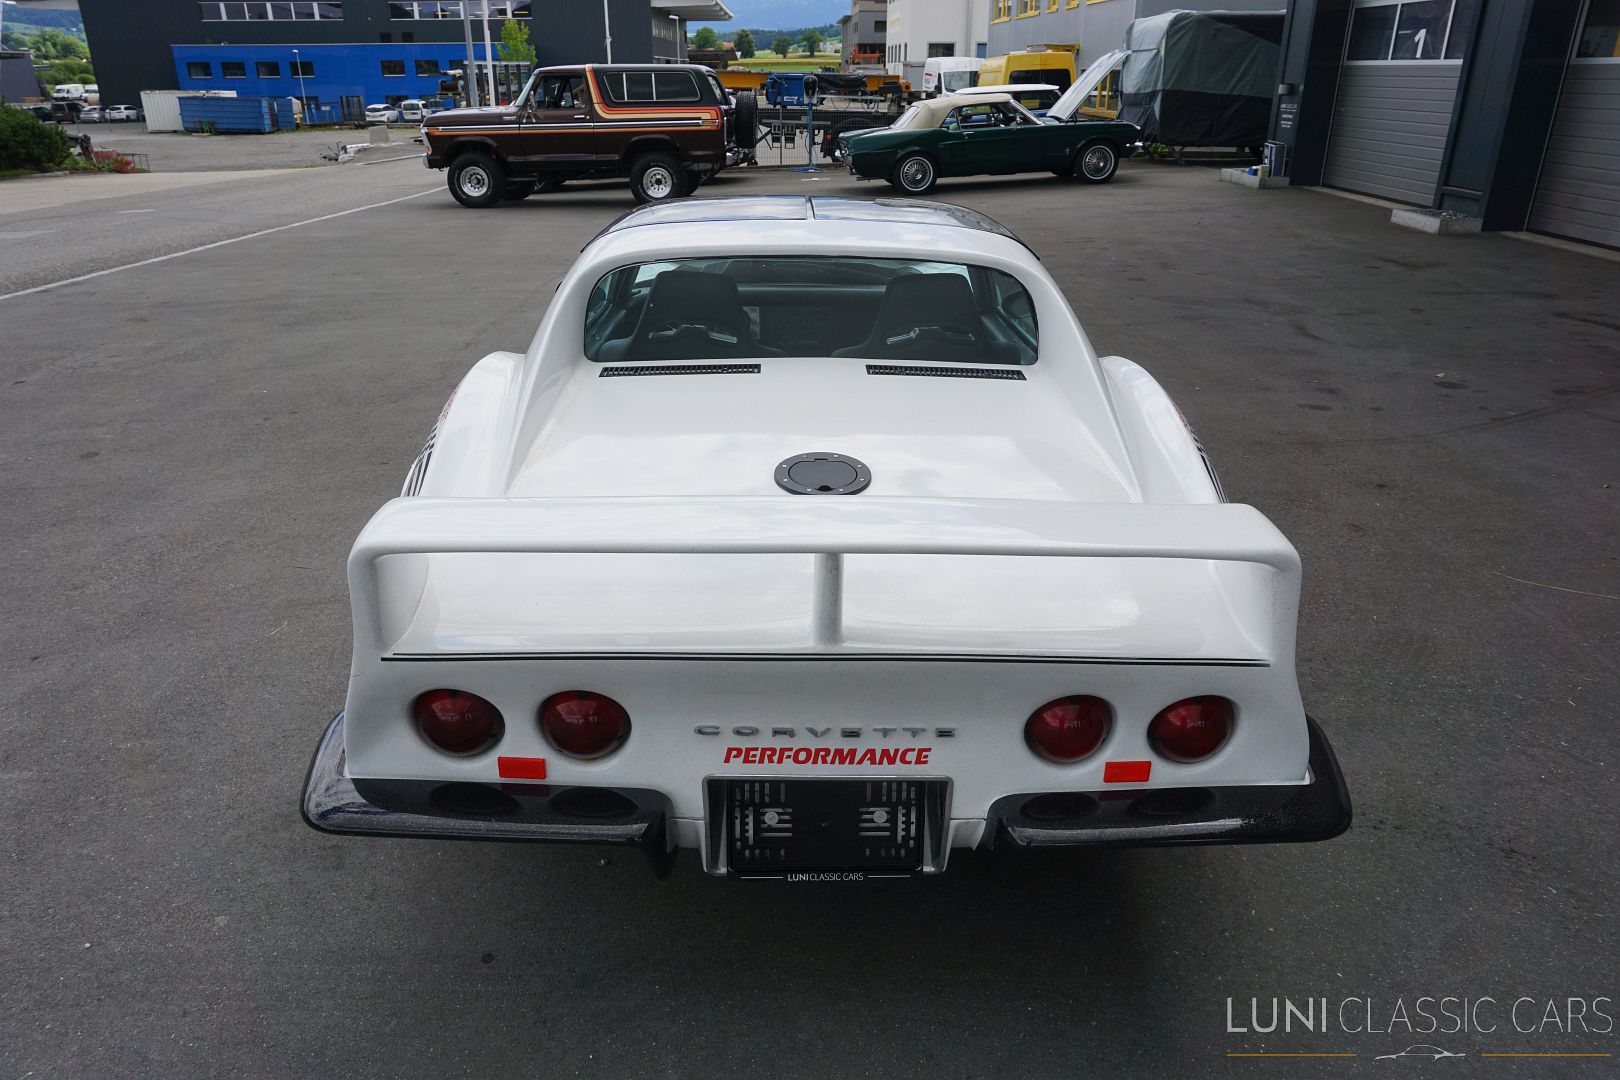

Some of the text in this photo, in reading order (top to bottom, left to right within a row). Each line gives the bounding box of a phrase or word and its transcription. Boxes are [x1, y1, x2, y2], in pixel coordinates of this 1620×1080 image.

[1414, 28, 1427, 58] 1
[693, 725, 956, 738] CORVETTE
[723, 747, 932, 766] PERFORMANCE
[787, 872, 864, 882] LUNI CLASSIC CARS
